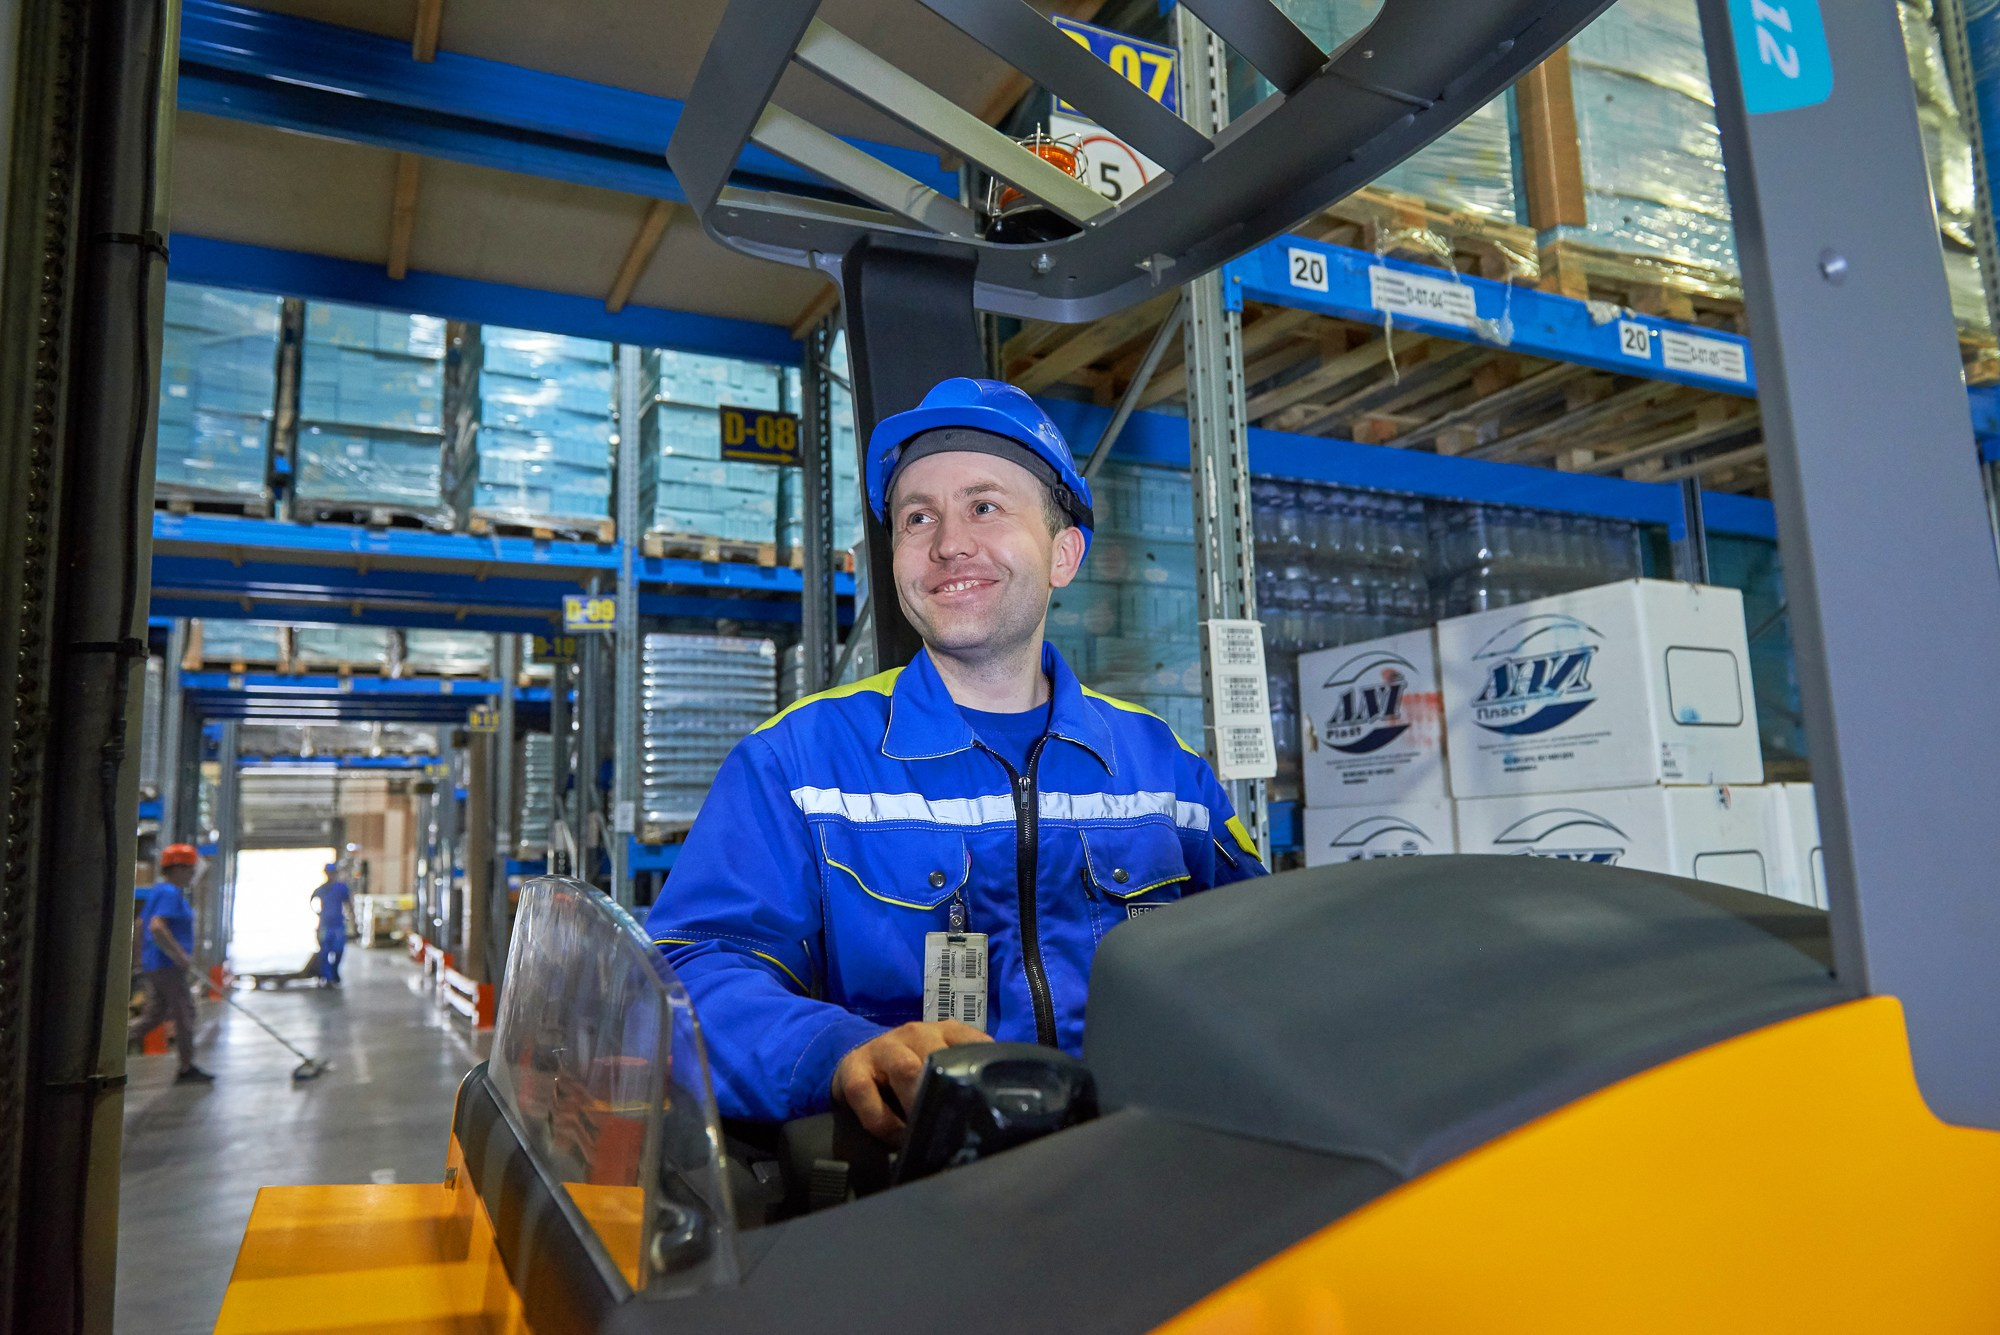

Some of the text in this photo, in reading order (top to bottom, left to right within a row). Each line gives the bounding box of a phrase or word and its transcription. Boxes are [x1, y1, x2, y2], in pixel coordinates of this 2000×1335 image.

[1100, 162, 1123, 201] 5
[1294, 256, 1323, 284] 20
[1624, 327, 1647, 352] 20
[724, 411, 796, 451] D-08
[566, 598, 615, 622] D-09
